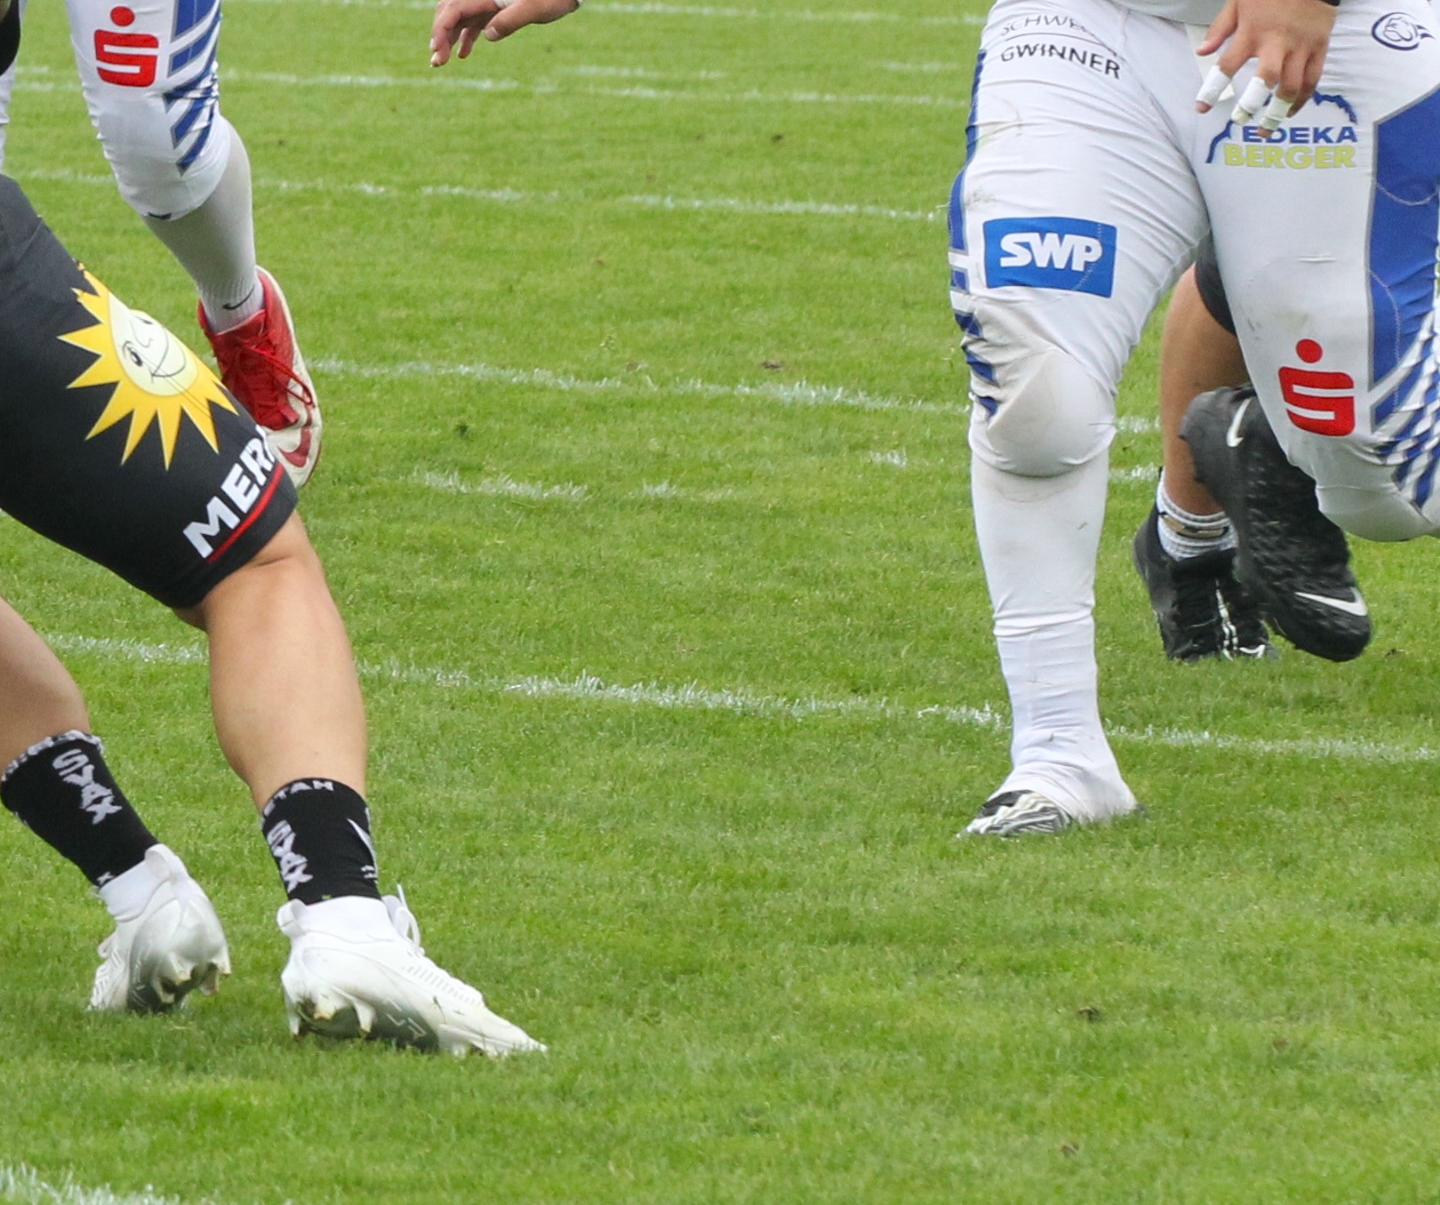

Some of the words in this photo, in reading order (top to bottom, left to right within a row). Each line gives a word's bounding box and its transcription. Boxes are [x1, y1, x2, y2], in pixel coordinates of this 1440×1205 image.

[1001, 43, 1120, 80] GWINNER
[1242, 125, 1358, 144] EDEKA
[1223, 144, 1358, 169] BERGER
[1000, 232, 1103, 272] SWP
[183, 423, 278, 560] MER
